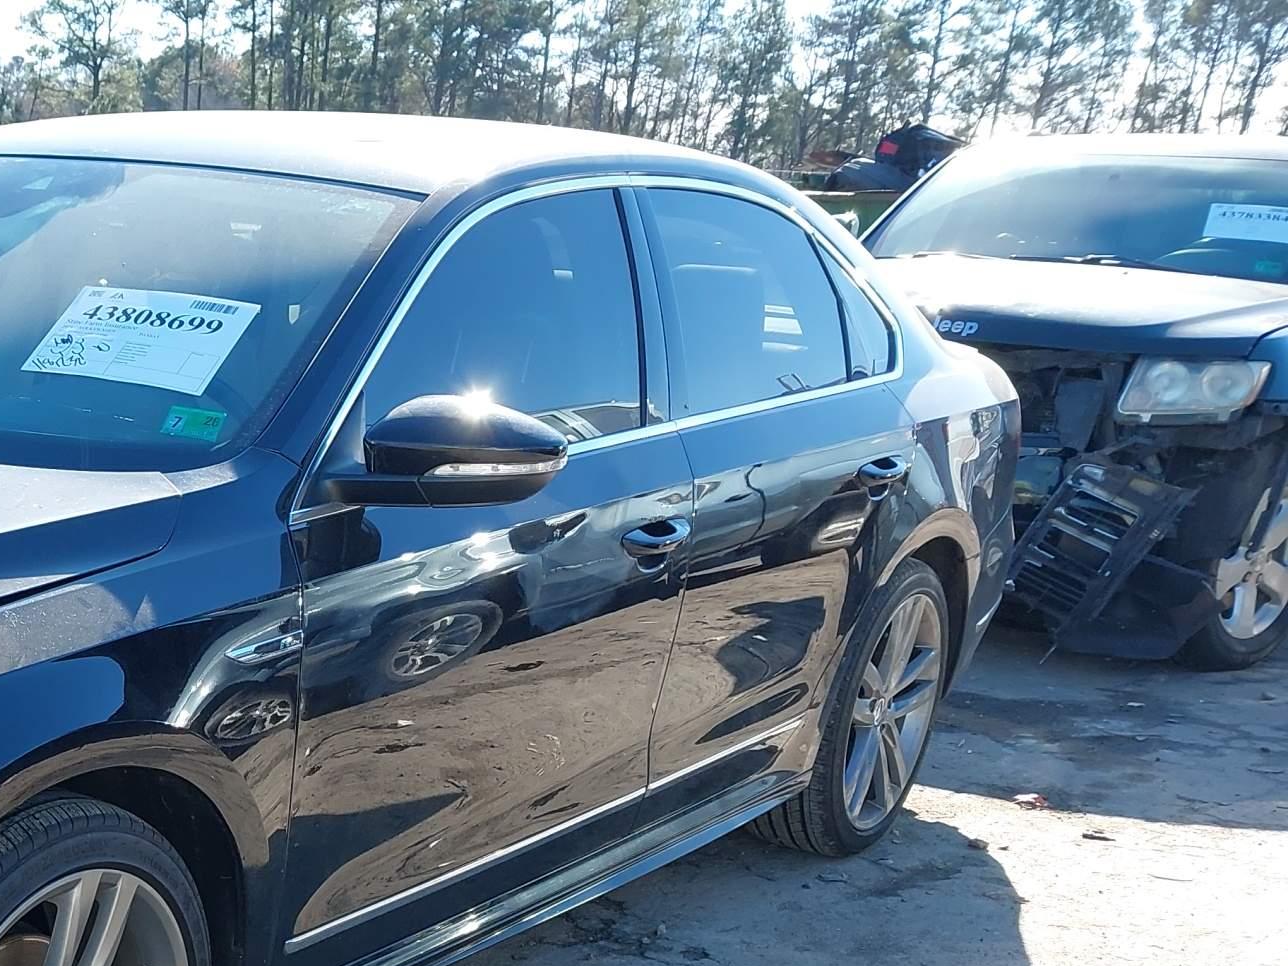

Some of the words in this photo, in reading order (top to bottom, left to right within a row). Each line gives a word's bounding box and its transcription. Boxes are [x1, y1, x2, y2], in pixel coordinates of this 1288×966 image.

[83, 304, 224, 335] 43808699
[933, 315, 979, 336] Jeep
[172, 416, 184, 429] 7
